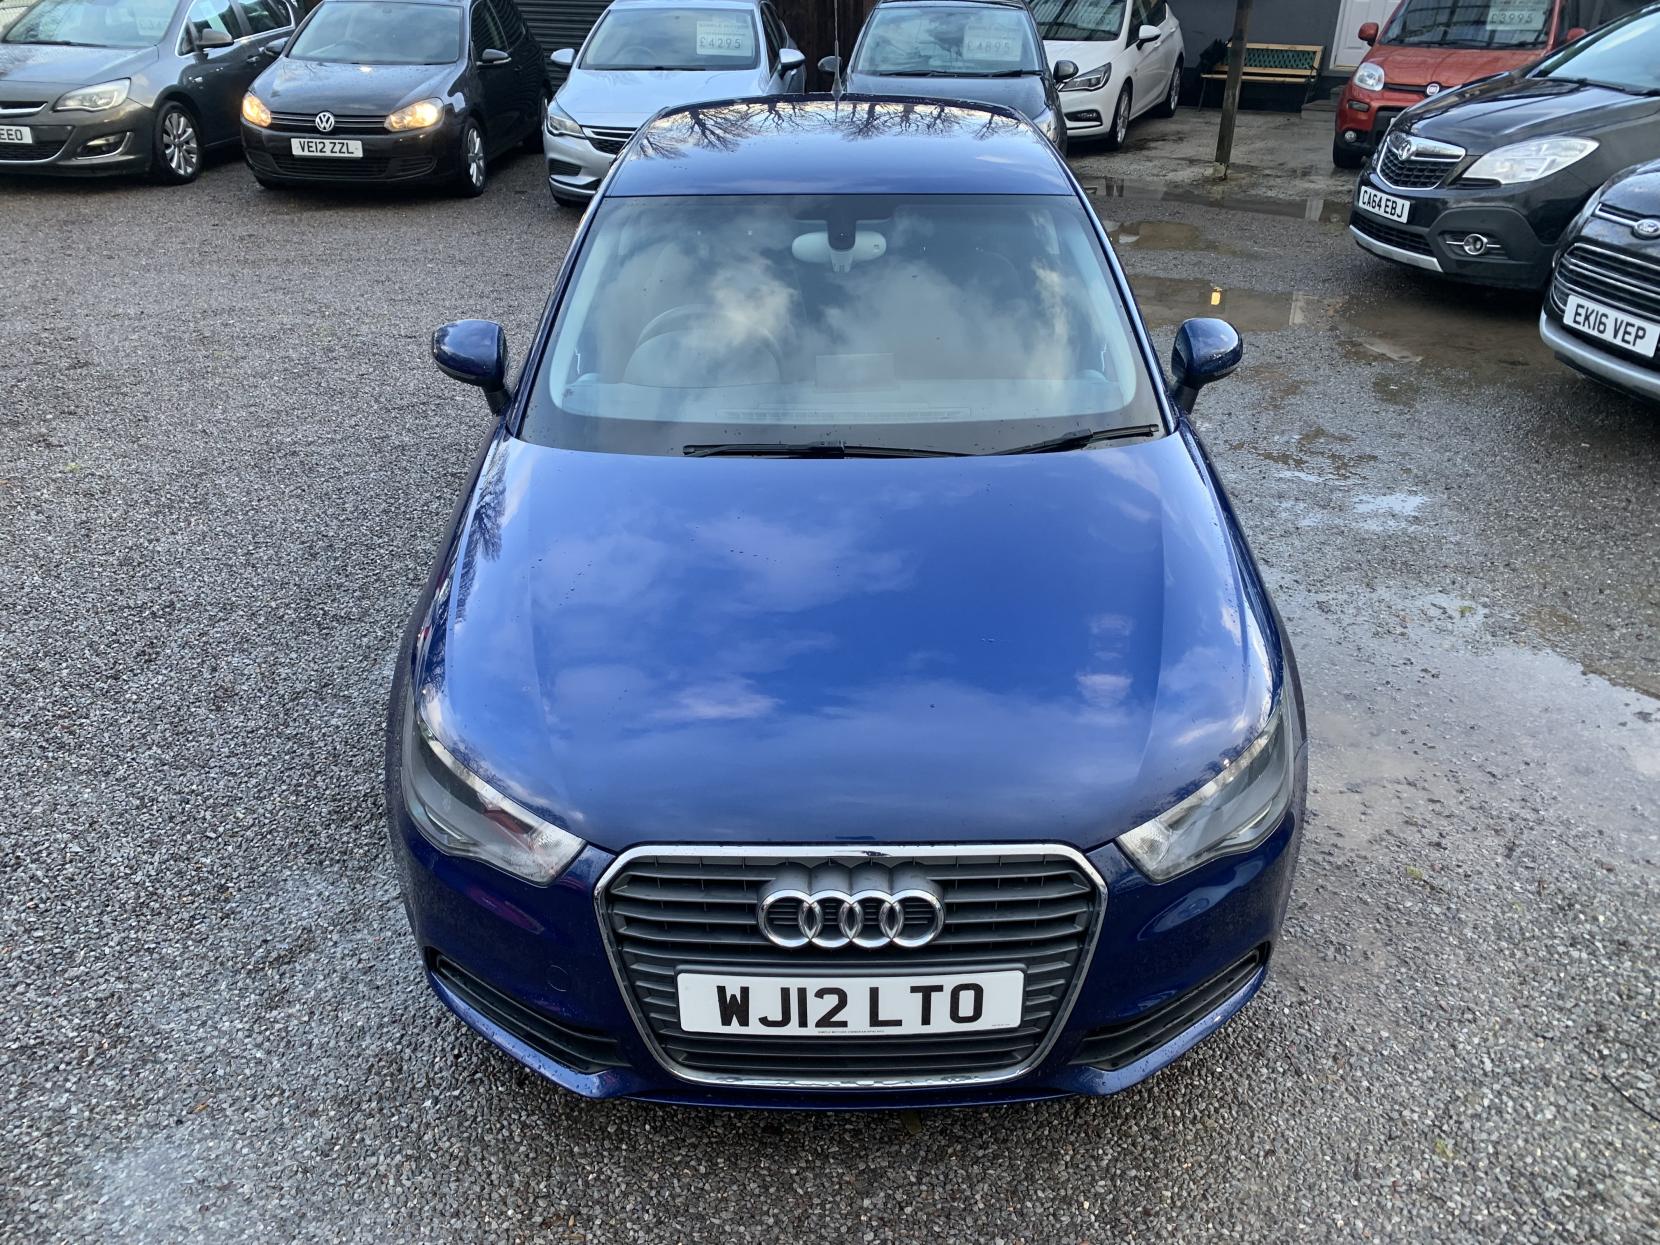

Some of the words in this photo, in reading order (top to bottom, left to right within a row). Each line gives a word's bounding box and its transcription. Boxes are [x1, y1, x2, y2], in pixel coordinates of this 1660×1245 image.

[1489, 12, 1533, 24] £3995
[699, 36, 741, 49] £4295
[299, 141, 327, 153] VE12
[329, 142, 355, 155] ZZL
[1362, 189, 1383, 212] CA64
[1383, 198, 1405, 218] EBJ
[1572, 303, 1609, 335] EK16
[1613, 317, 1647, 347] VEP
[716, 985, 848, 1028] WJ12
[869, 983, 984, 1026] LTO
